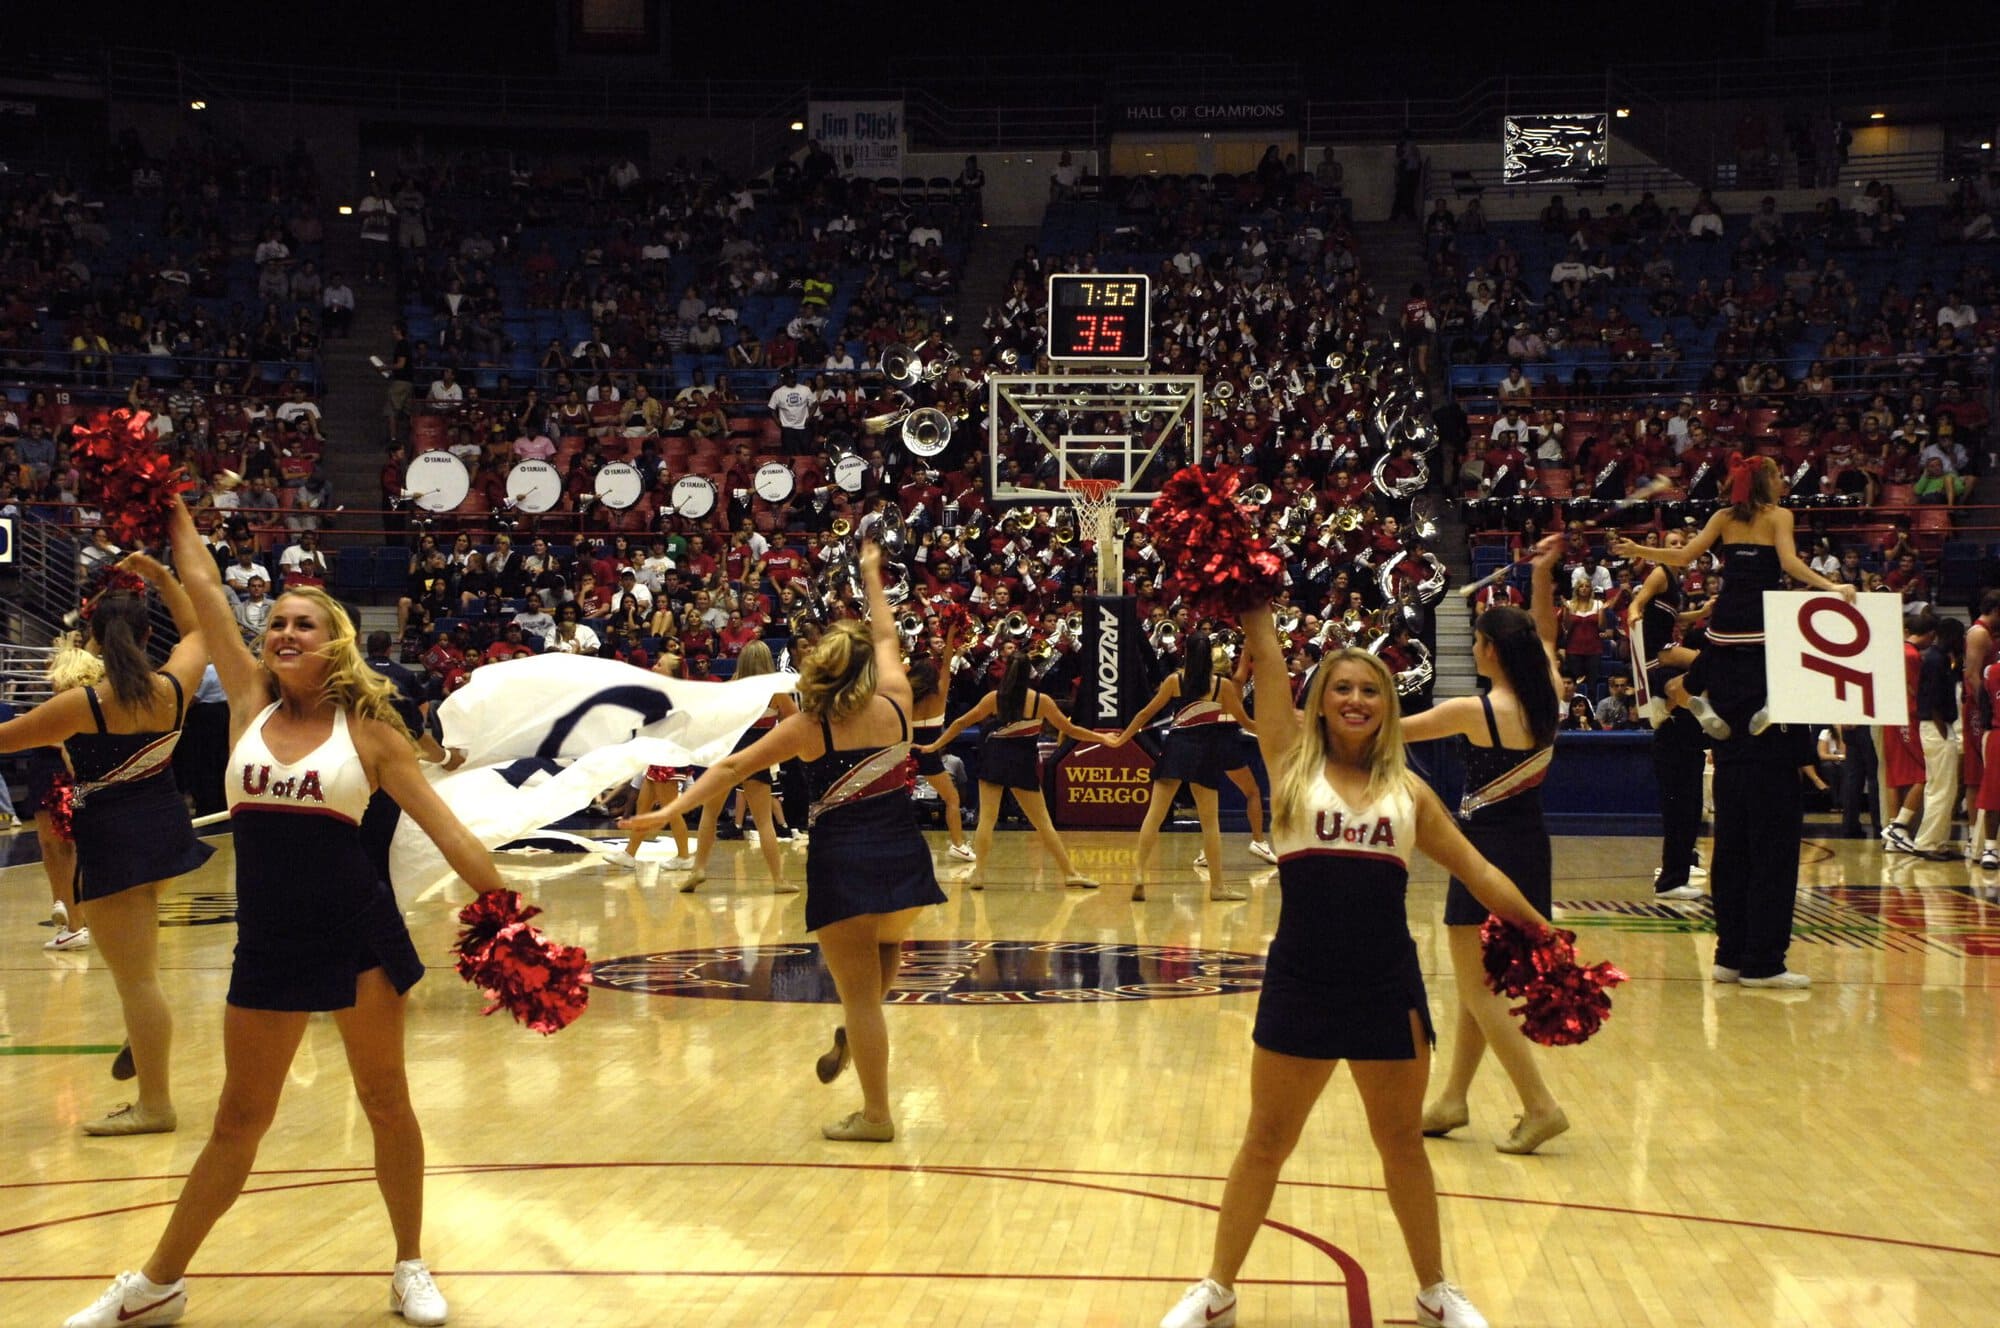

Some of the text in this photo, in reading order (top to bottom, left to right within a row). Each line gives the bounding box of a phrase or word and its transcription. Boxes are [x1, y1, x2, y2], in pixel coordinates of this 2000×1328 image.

[1127, 103, 1285, 119] HALL OF CHAMPIONS
[816, 112, 897, 140] Jim Click
[1081, 283, 1137, 306] 7:52
[1072, 315, 1124, 351] 35
[56, 392, 70, 405] 19
[1098, 605, 1120, 720] ARIZONA
[1797, 596, 1876, 719] OF
[243, 763, 325, 802] U of A
[1065, 767, 1151, 783] WELLS
[1067, 787, 1150, 804] FARGO
[1315, 810, 1396, 848] U of A
